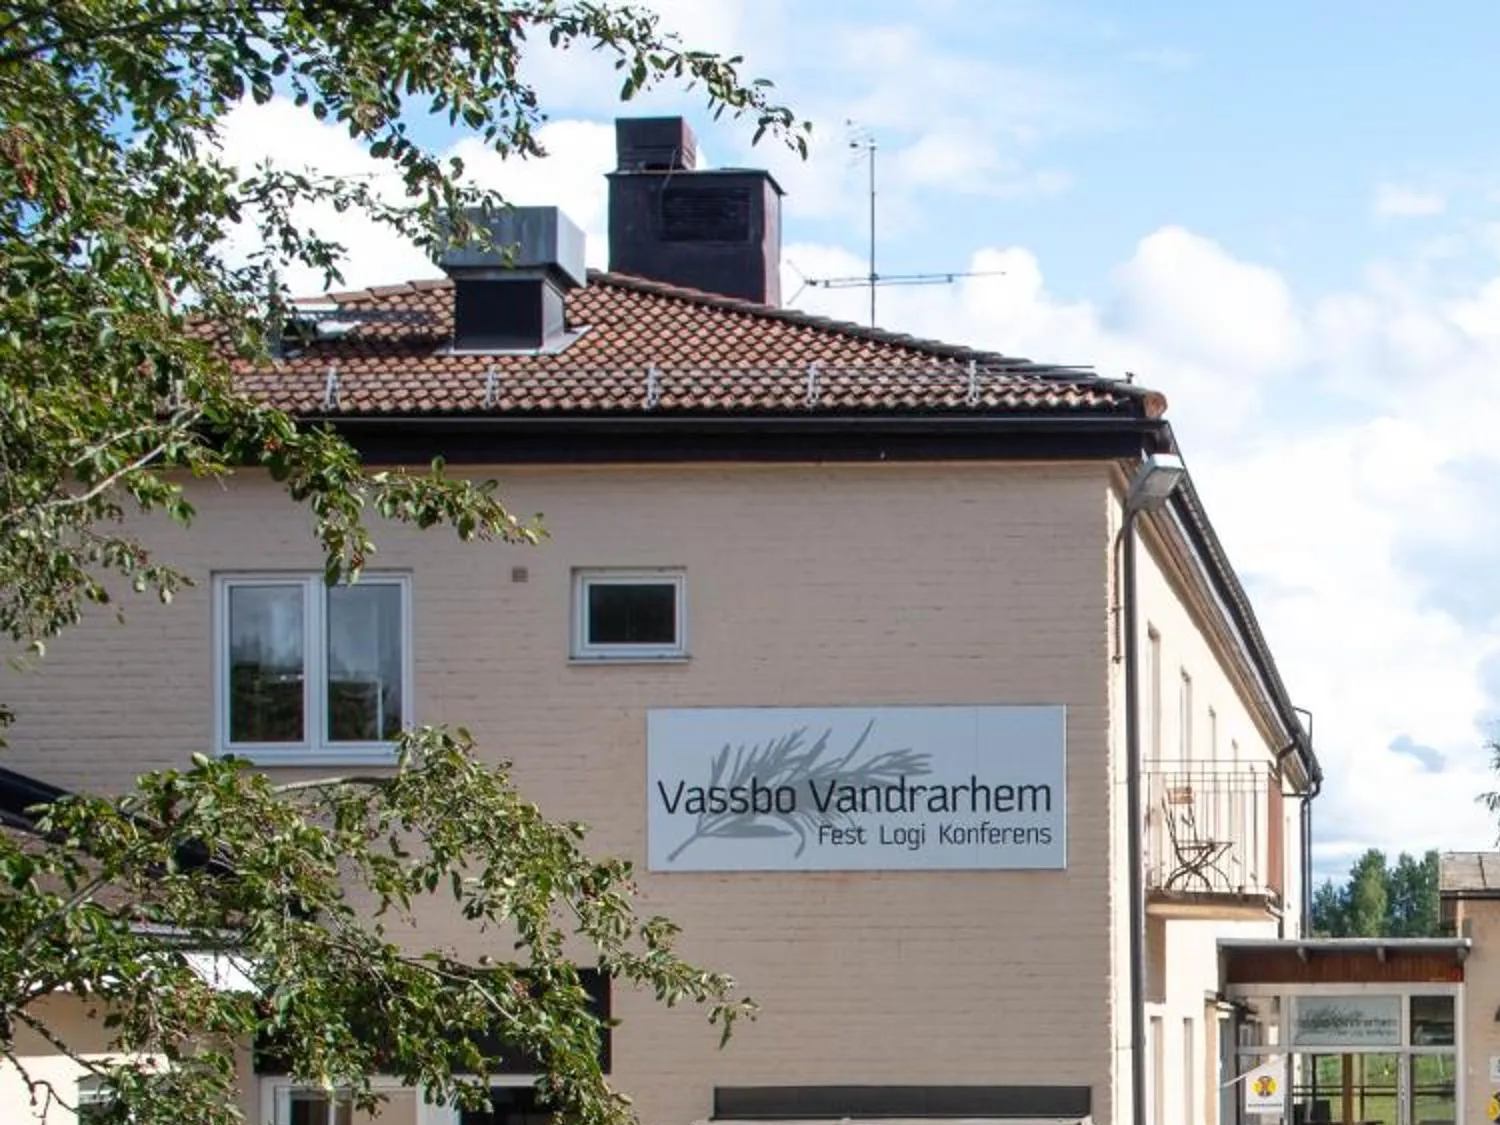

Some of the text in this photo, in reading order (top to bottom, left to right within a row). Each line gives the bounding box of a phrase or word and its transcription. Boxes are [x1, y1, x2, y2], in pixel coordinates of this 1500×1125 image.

[657, 774, 1051, 815] Vassbo Vandrarhem
[819, 821, 1052, 851] Fest Logi Konferens
